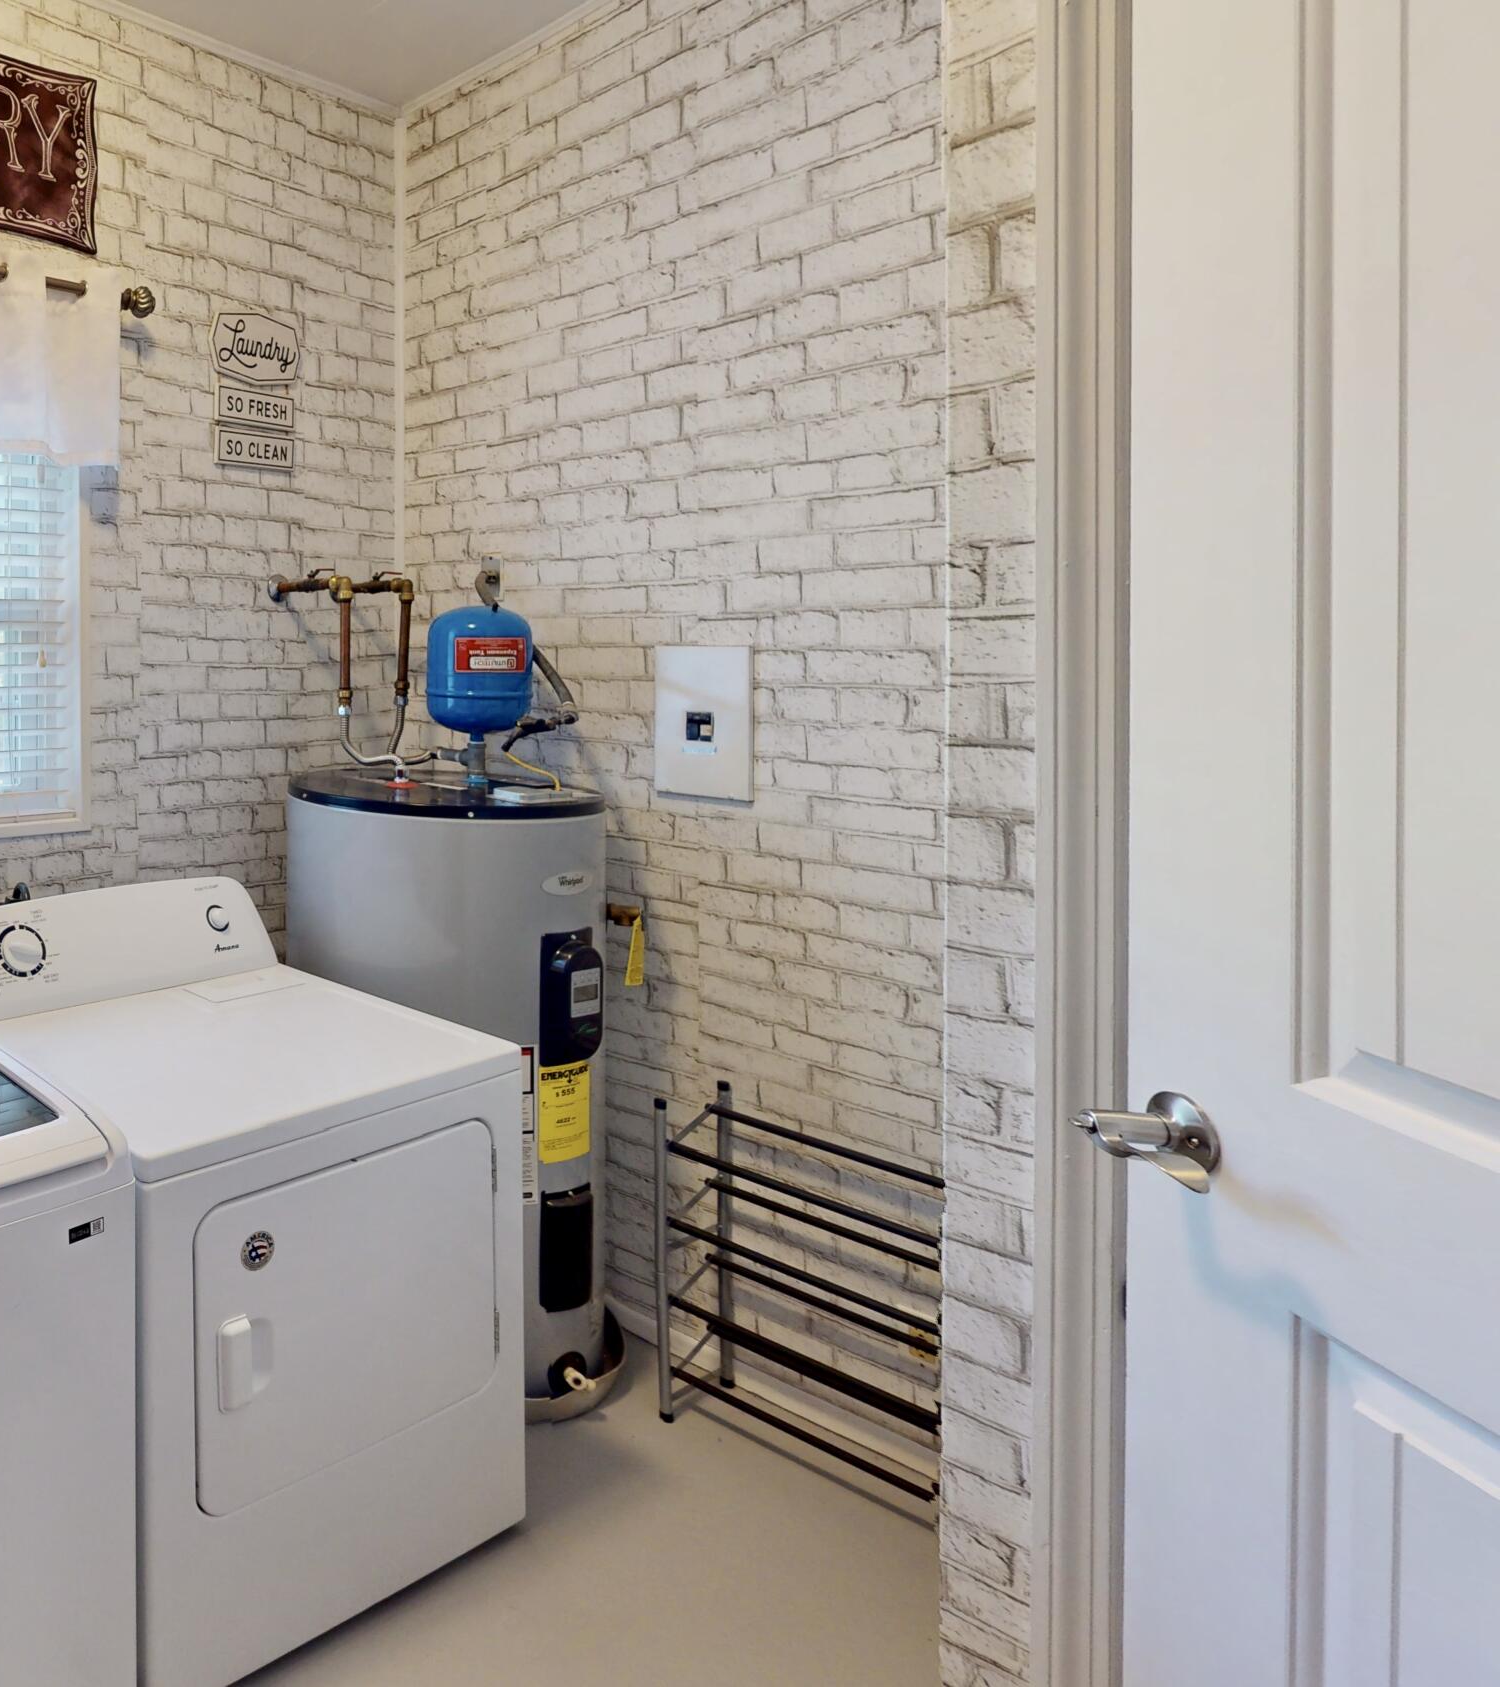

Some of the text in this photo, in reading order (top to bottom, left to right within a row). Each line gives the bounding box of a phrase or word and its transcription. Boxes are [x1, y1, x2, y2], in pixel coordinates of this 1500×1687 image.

[219, 319, 296, 372] Laundry
[227, 396, 287, 420] SO FRESH
[226, 440, 288, 462] SO CLEAN
[214, 944, 239, 953] Amana
